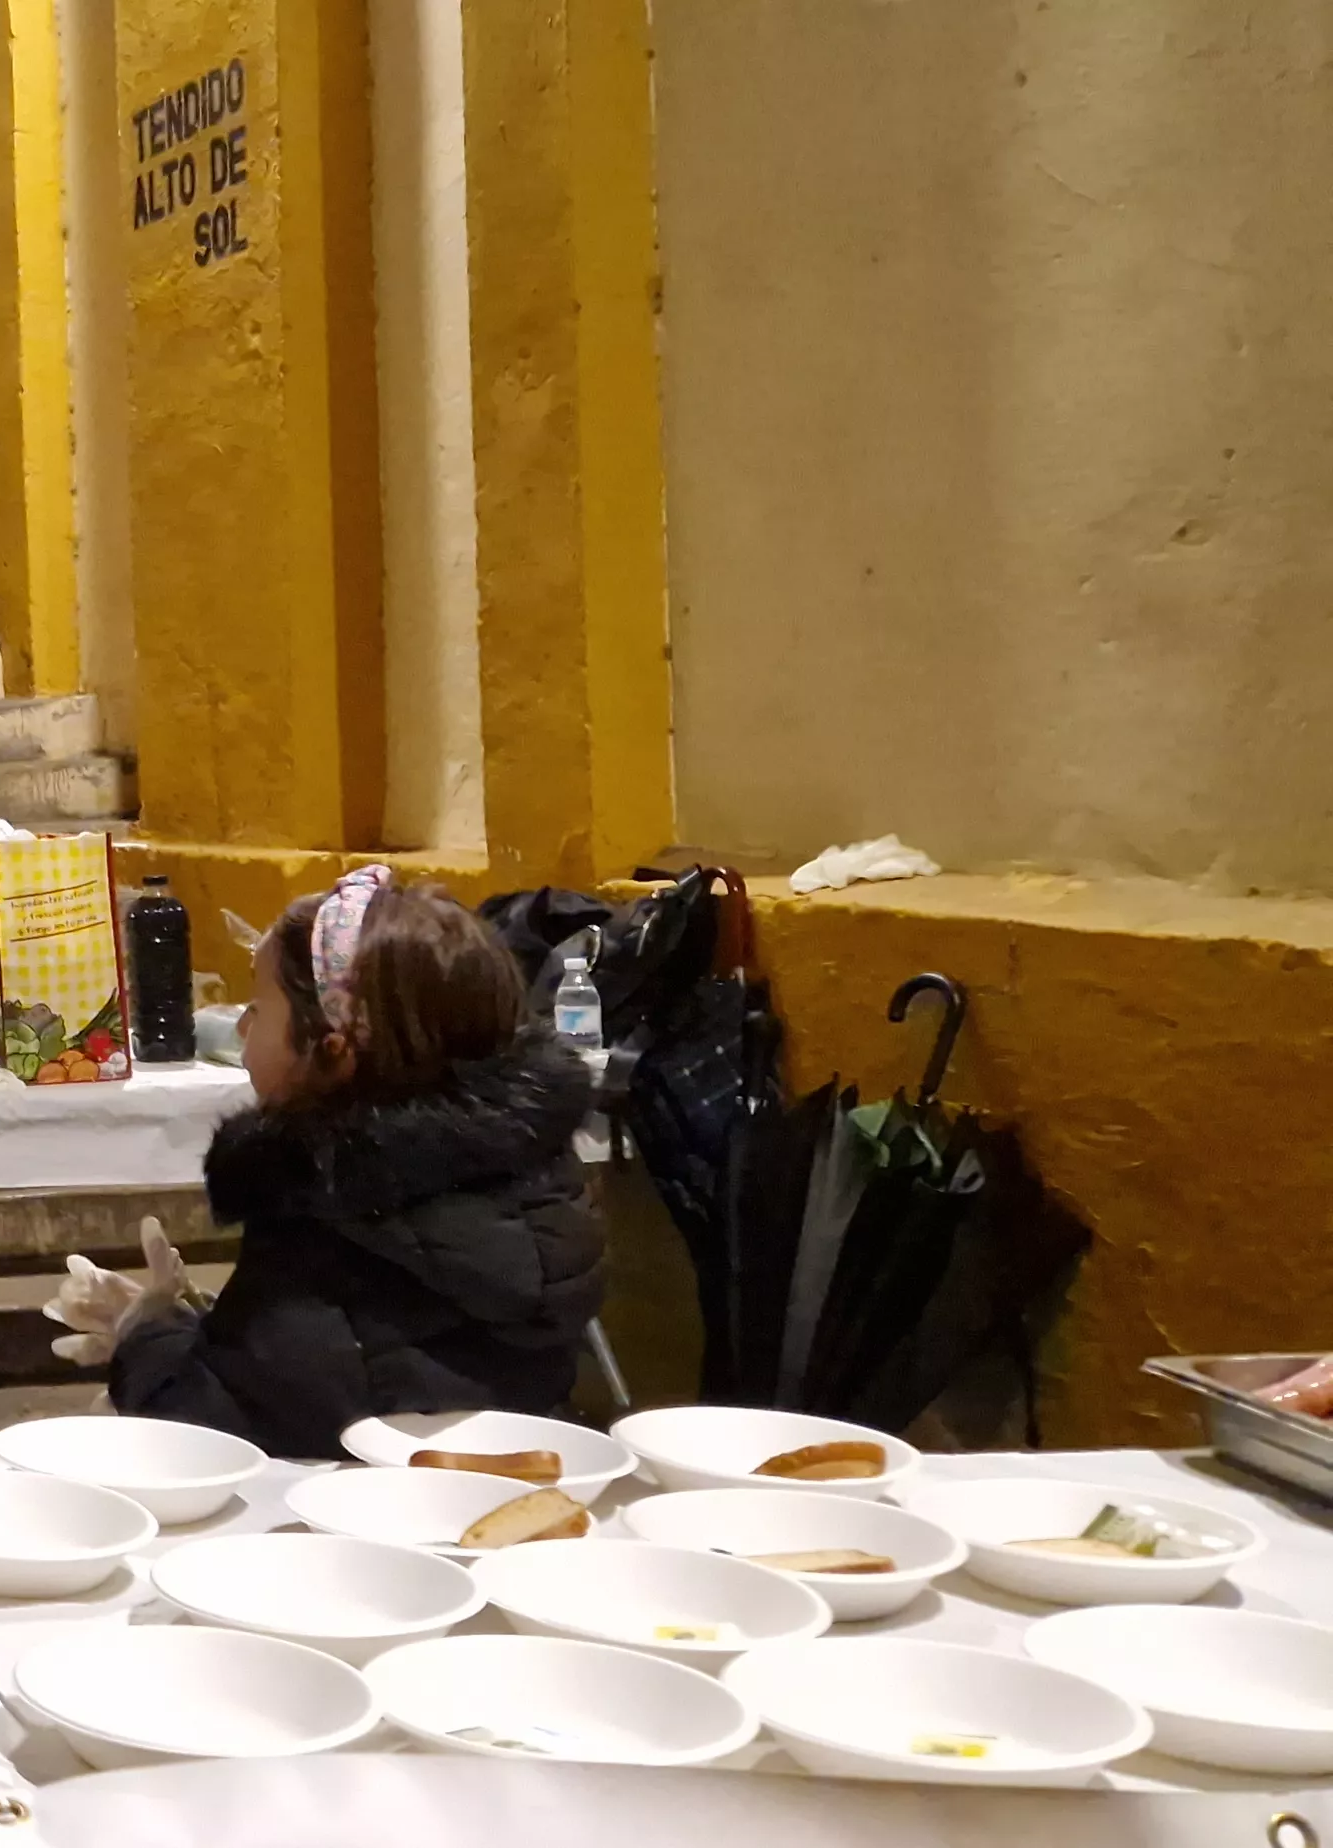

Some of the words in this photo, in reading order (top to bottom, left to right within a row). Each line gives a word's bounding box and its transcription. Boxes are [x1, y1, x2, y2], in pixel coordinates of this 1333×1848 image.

[133, 58, 244, 163] TENDIDO
[134, 152, 195, 231] ALTO
[210, 125, 246, 194] DE
[194, 200, 248, 267] SOL
